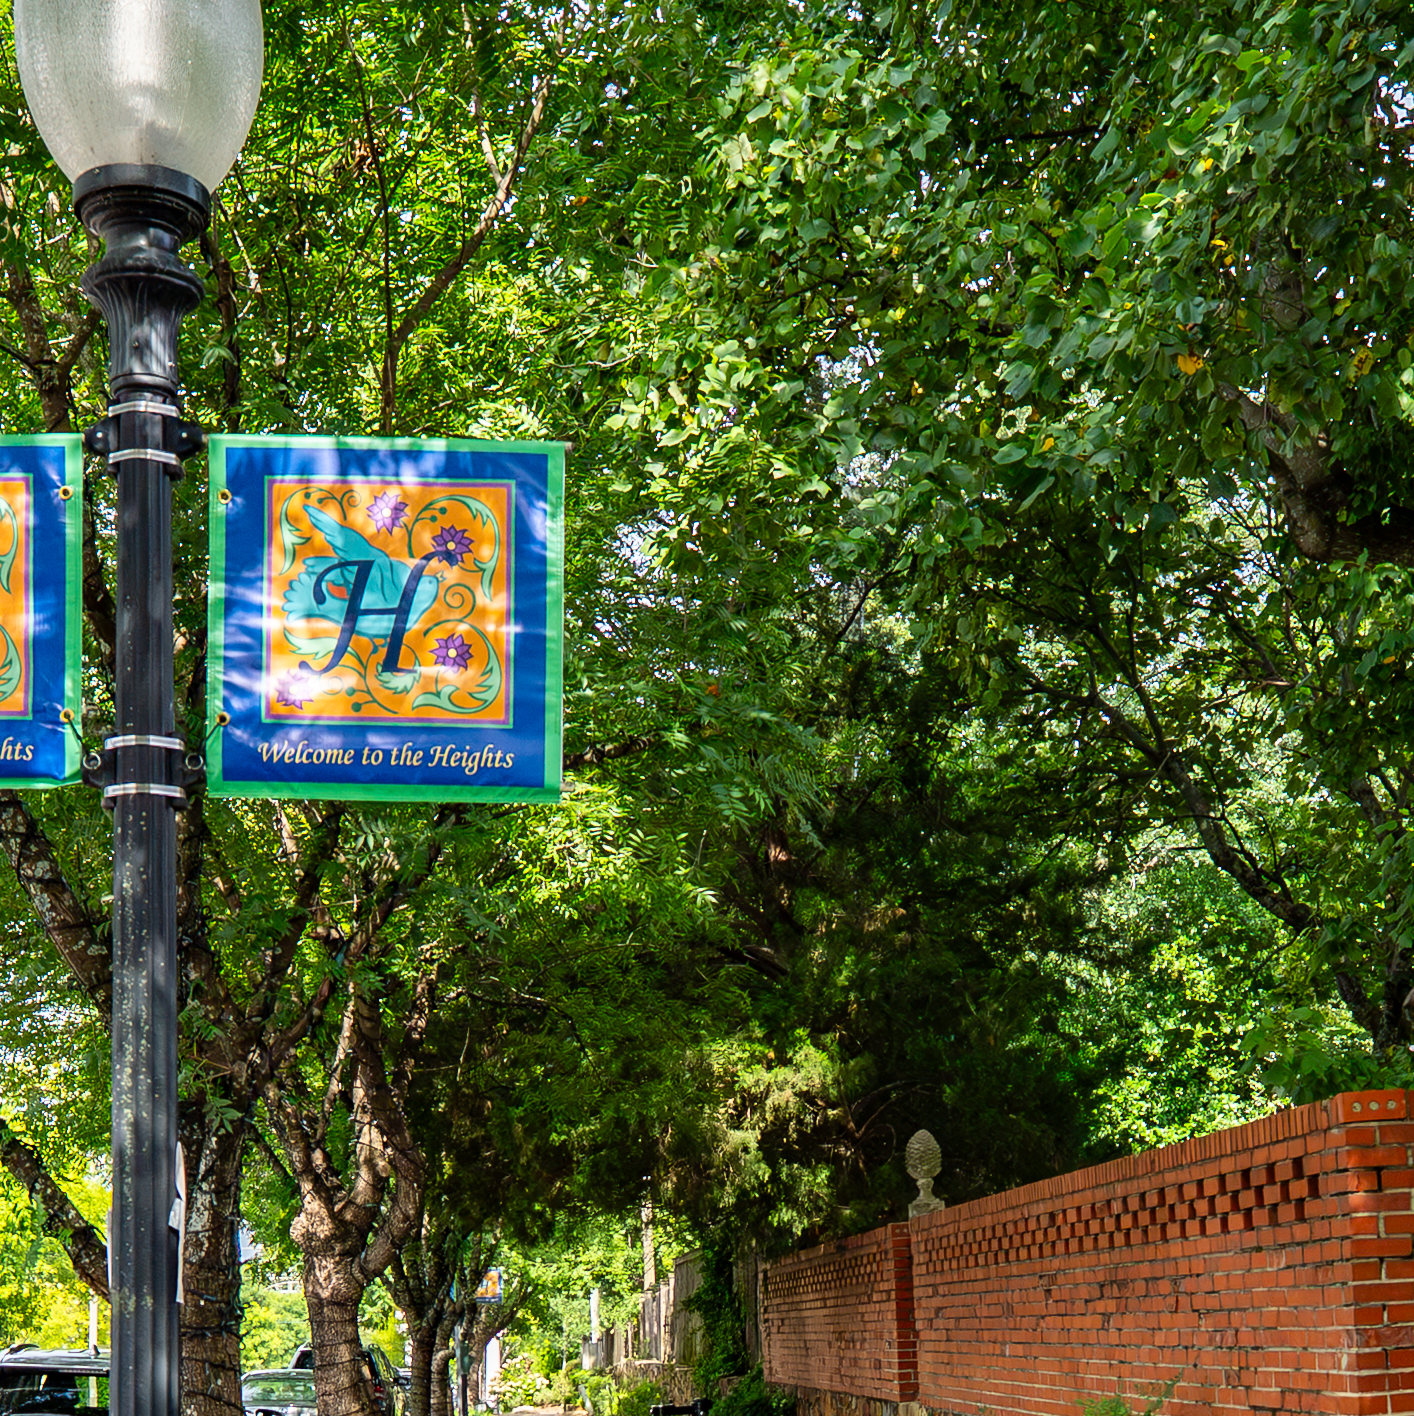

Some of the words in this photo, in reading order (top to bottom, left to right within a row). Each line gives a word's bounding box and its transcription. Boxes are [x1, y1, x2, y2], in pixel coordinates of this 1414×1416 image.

[298, 550, 460, 675] H
[257, 740, 355, 765] Welcome
[362, 746, 383, 766] to
[390, 742, 424, 767] the
[428, 743, 515, 776] Heights
